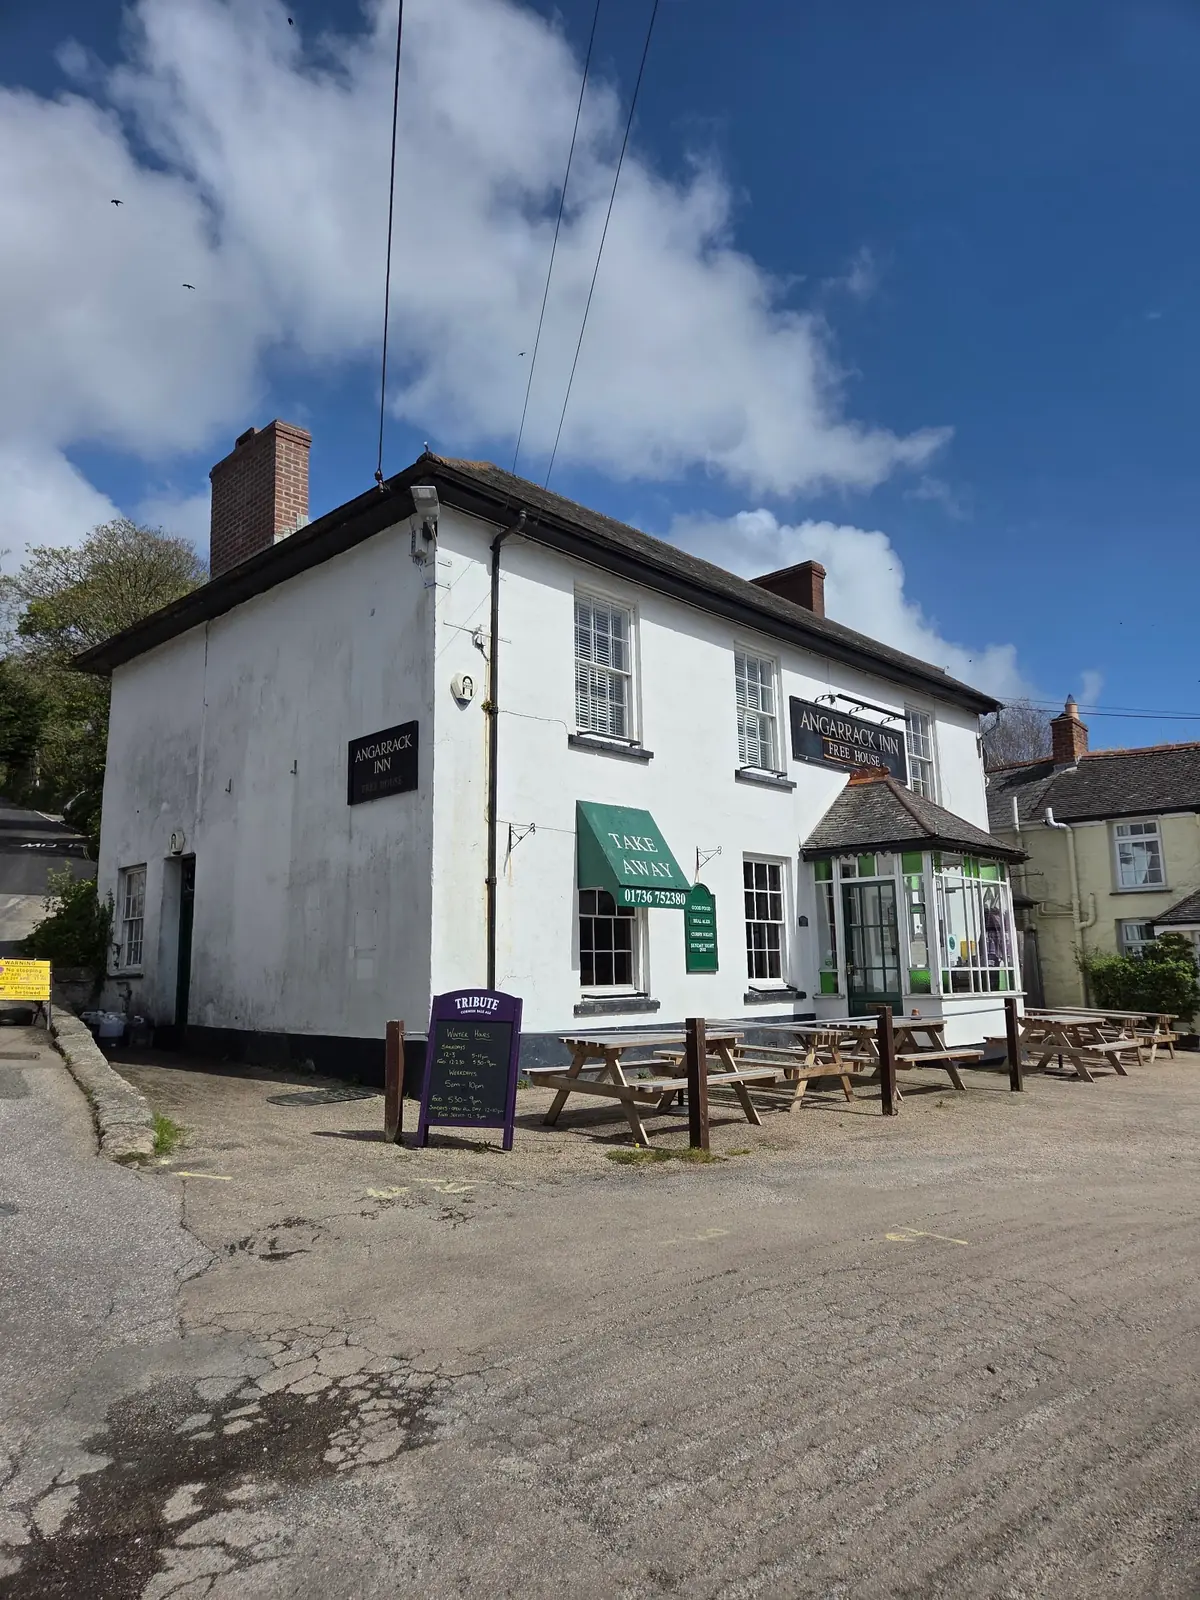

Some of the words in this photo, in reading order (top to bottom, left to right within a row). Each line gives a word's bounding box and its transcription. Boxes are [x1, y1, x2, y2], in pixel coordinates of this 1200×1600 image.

[800, 710, 877, 750] ANGARRACK
[878, 733, 899, 756] INN
[355, 734, 412, 763] ANGARRACK
[829, 742, 850, 758] FREE
[854, 750, 880, 767] HOUSE
[374, 757, 391, 774] INN
[608, 832, 659, 853] TAKE
[623, 859, 674, 878] AWAY
[624, 889, 653, 903] 01736
[654, 890, 686, 905] 752380
[455, 996, 500, 1011] TRIBUTE
